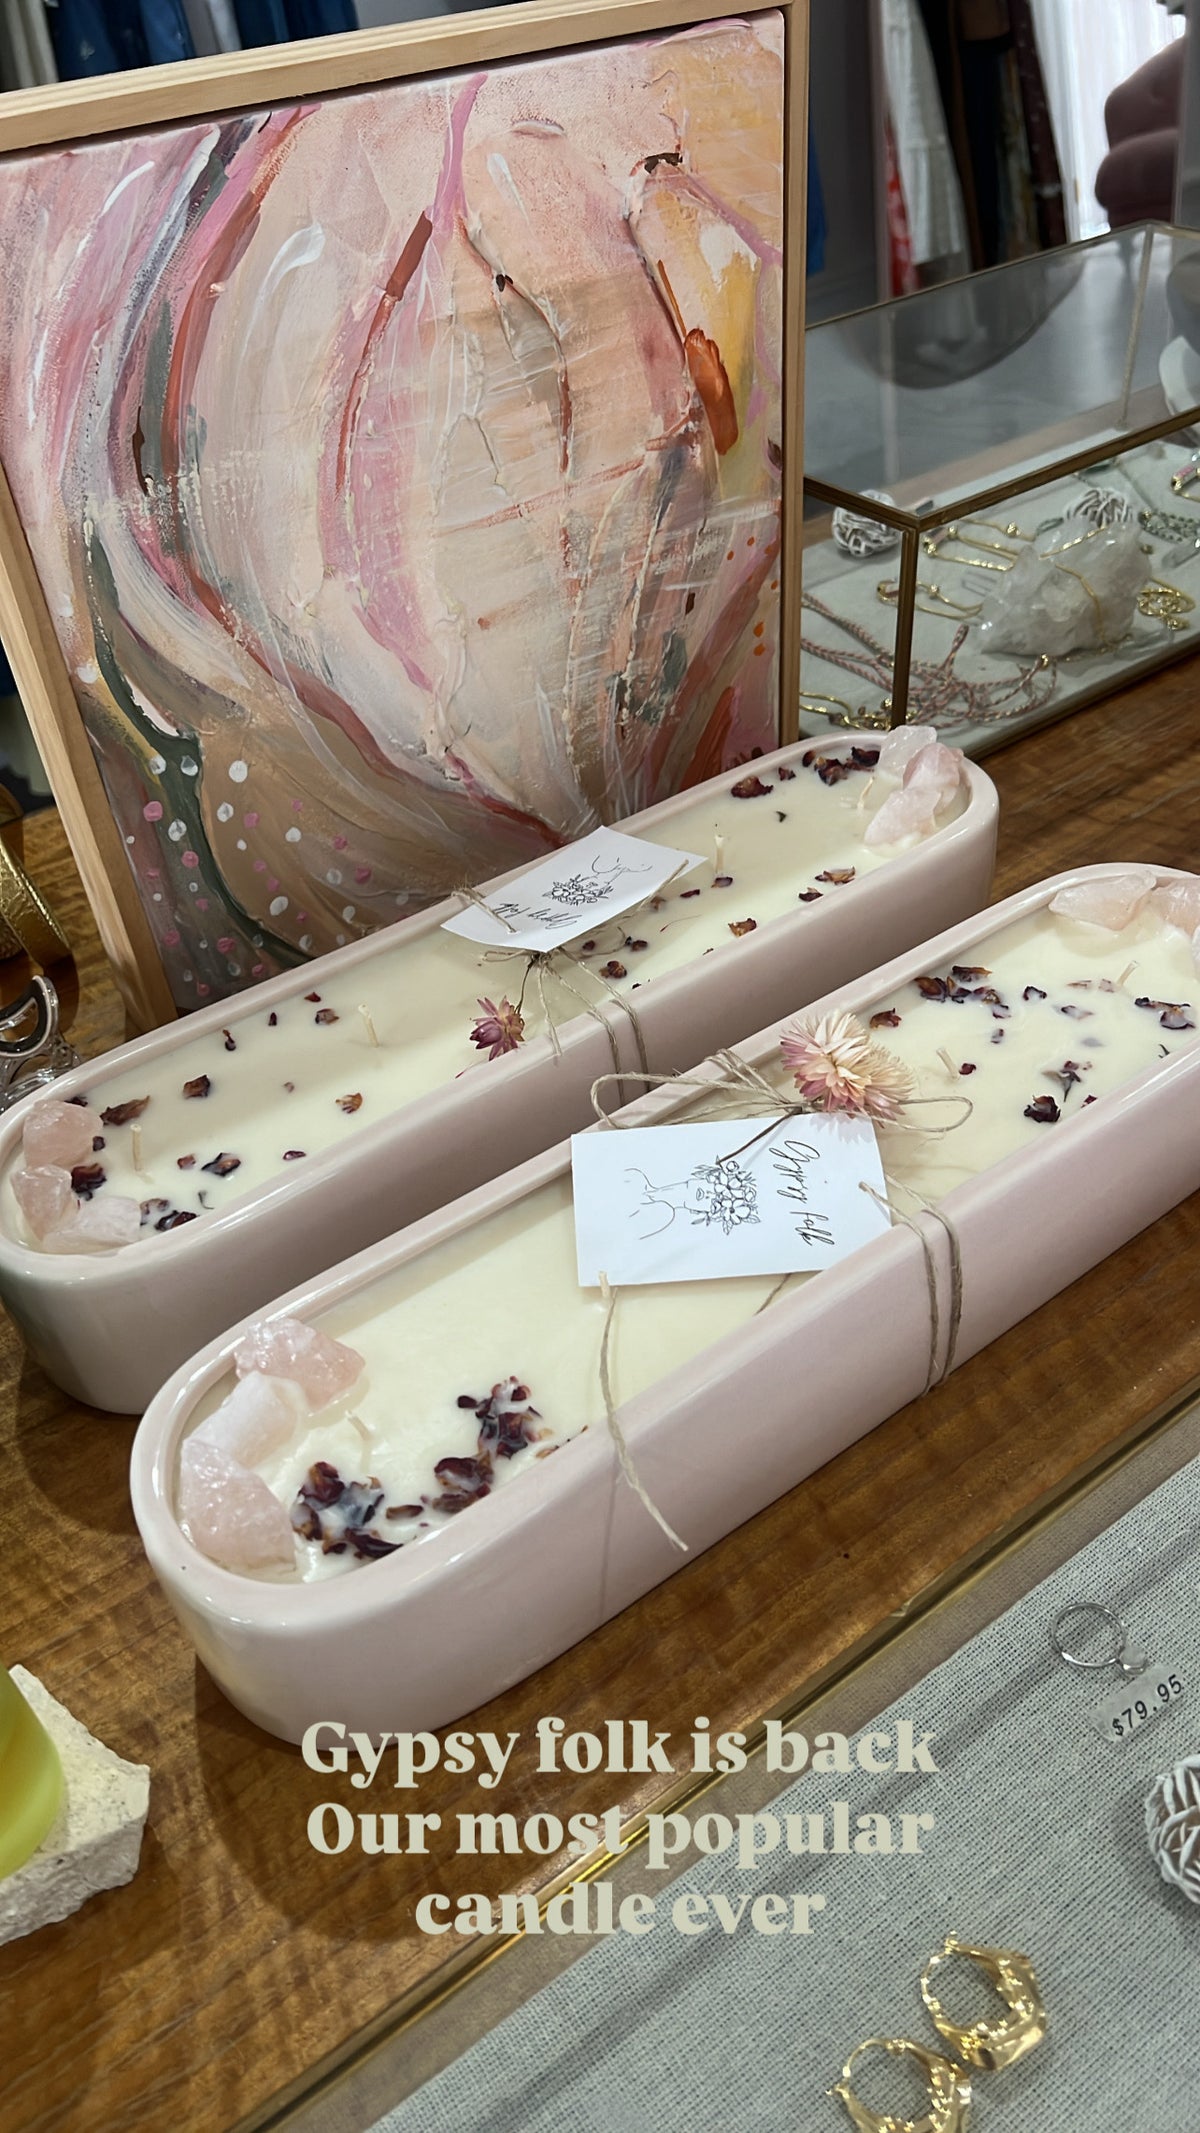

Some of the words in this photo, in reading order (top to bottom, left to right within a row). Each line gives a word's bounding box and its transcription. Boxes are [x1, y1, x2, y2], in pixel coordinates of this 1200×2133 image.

[768, 1140, 821, 1205] Gypsy
[789, 1210, 836, 1247] folk
[1111, 1673, 1183, 1737] $79.95
